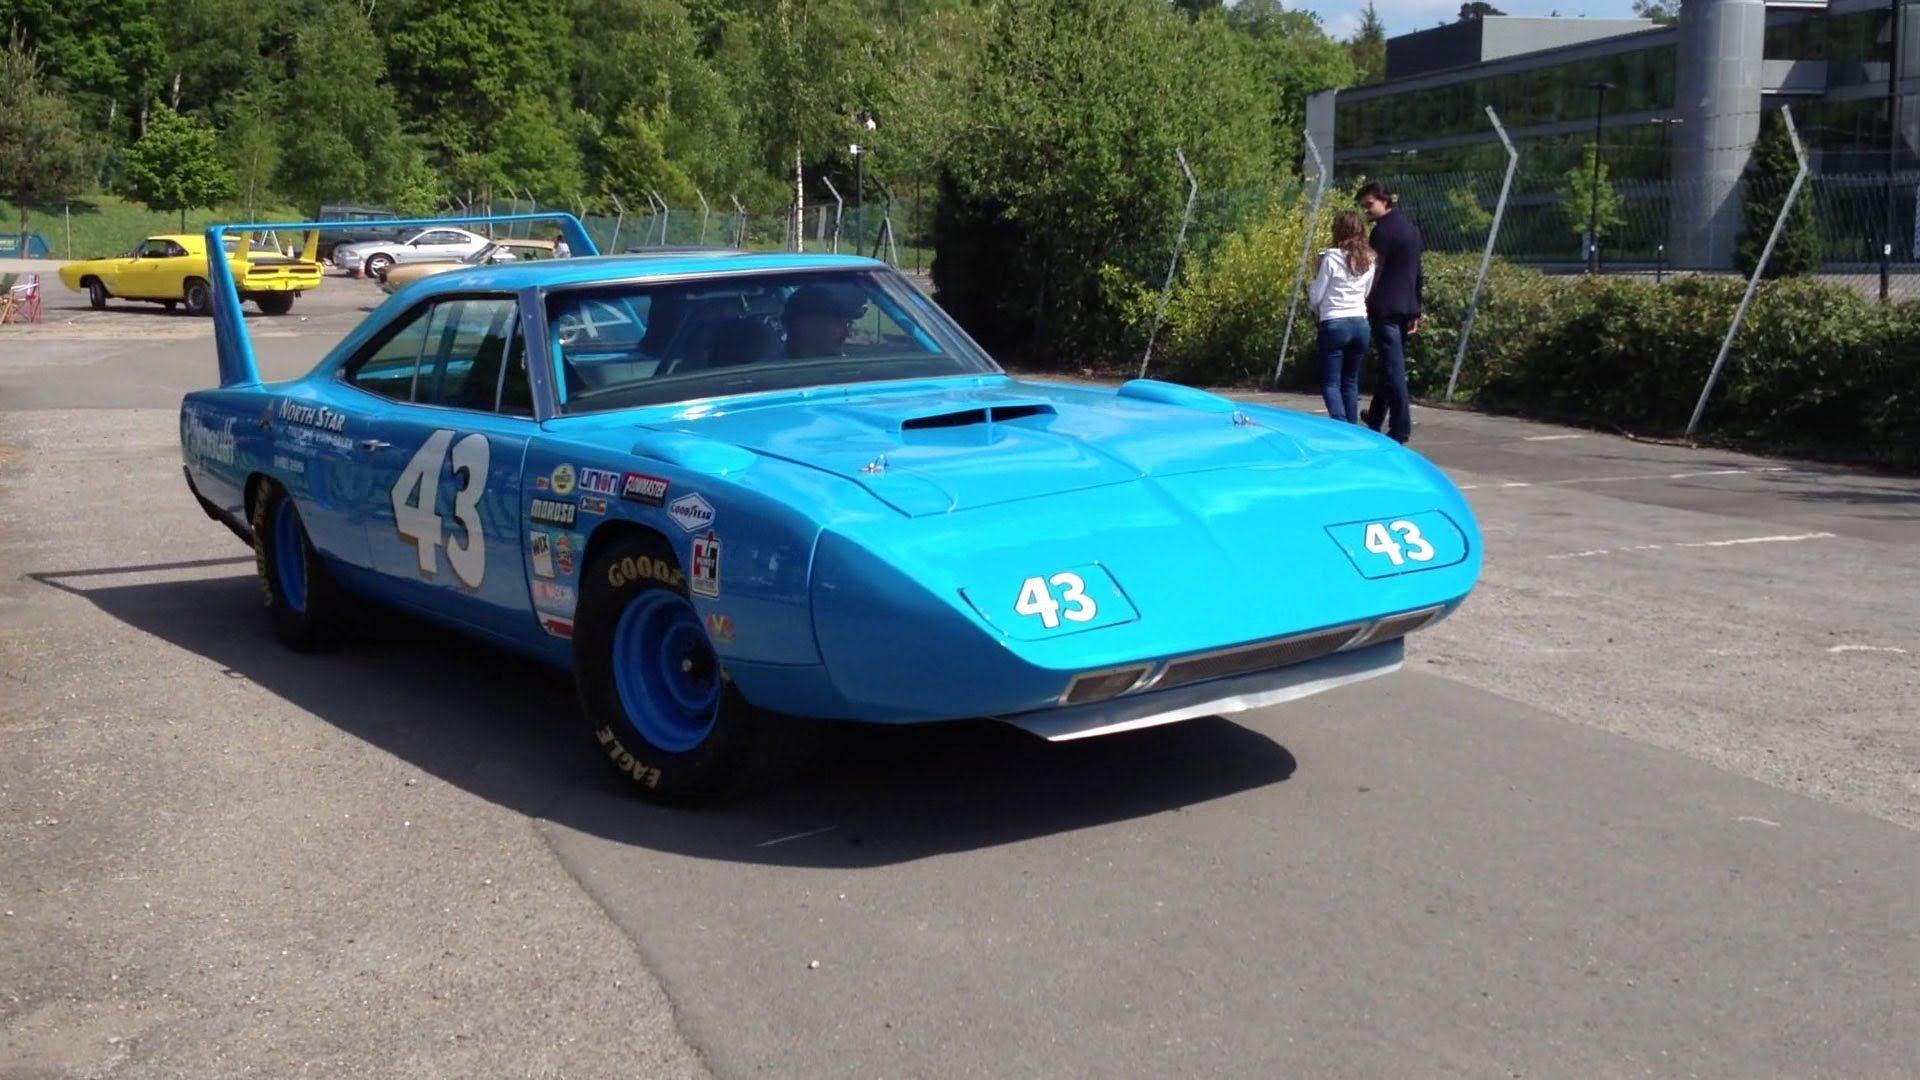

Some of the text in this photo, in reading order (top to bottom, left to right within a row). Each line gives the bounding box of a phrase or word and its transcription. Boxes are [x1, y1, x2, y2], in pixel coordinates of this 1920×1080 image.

[279, 398, 346, 432] NORTH STAR
[391, 429, 490, 589] 43
[1365, 519, 1435, 566] 43
[1014, 572, 1097, 629] 43
[596, 725, 661, 789] EAGLE
